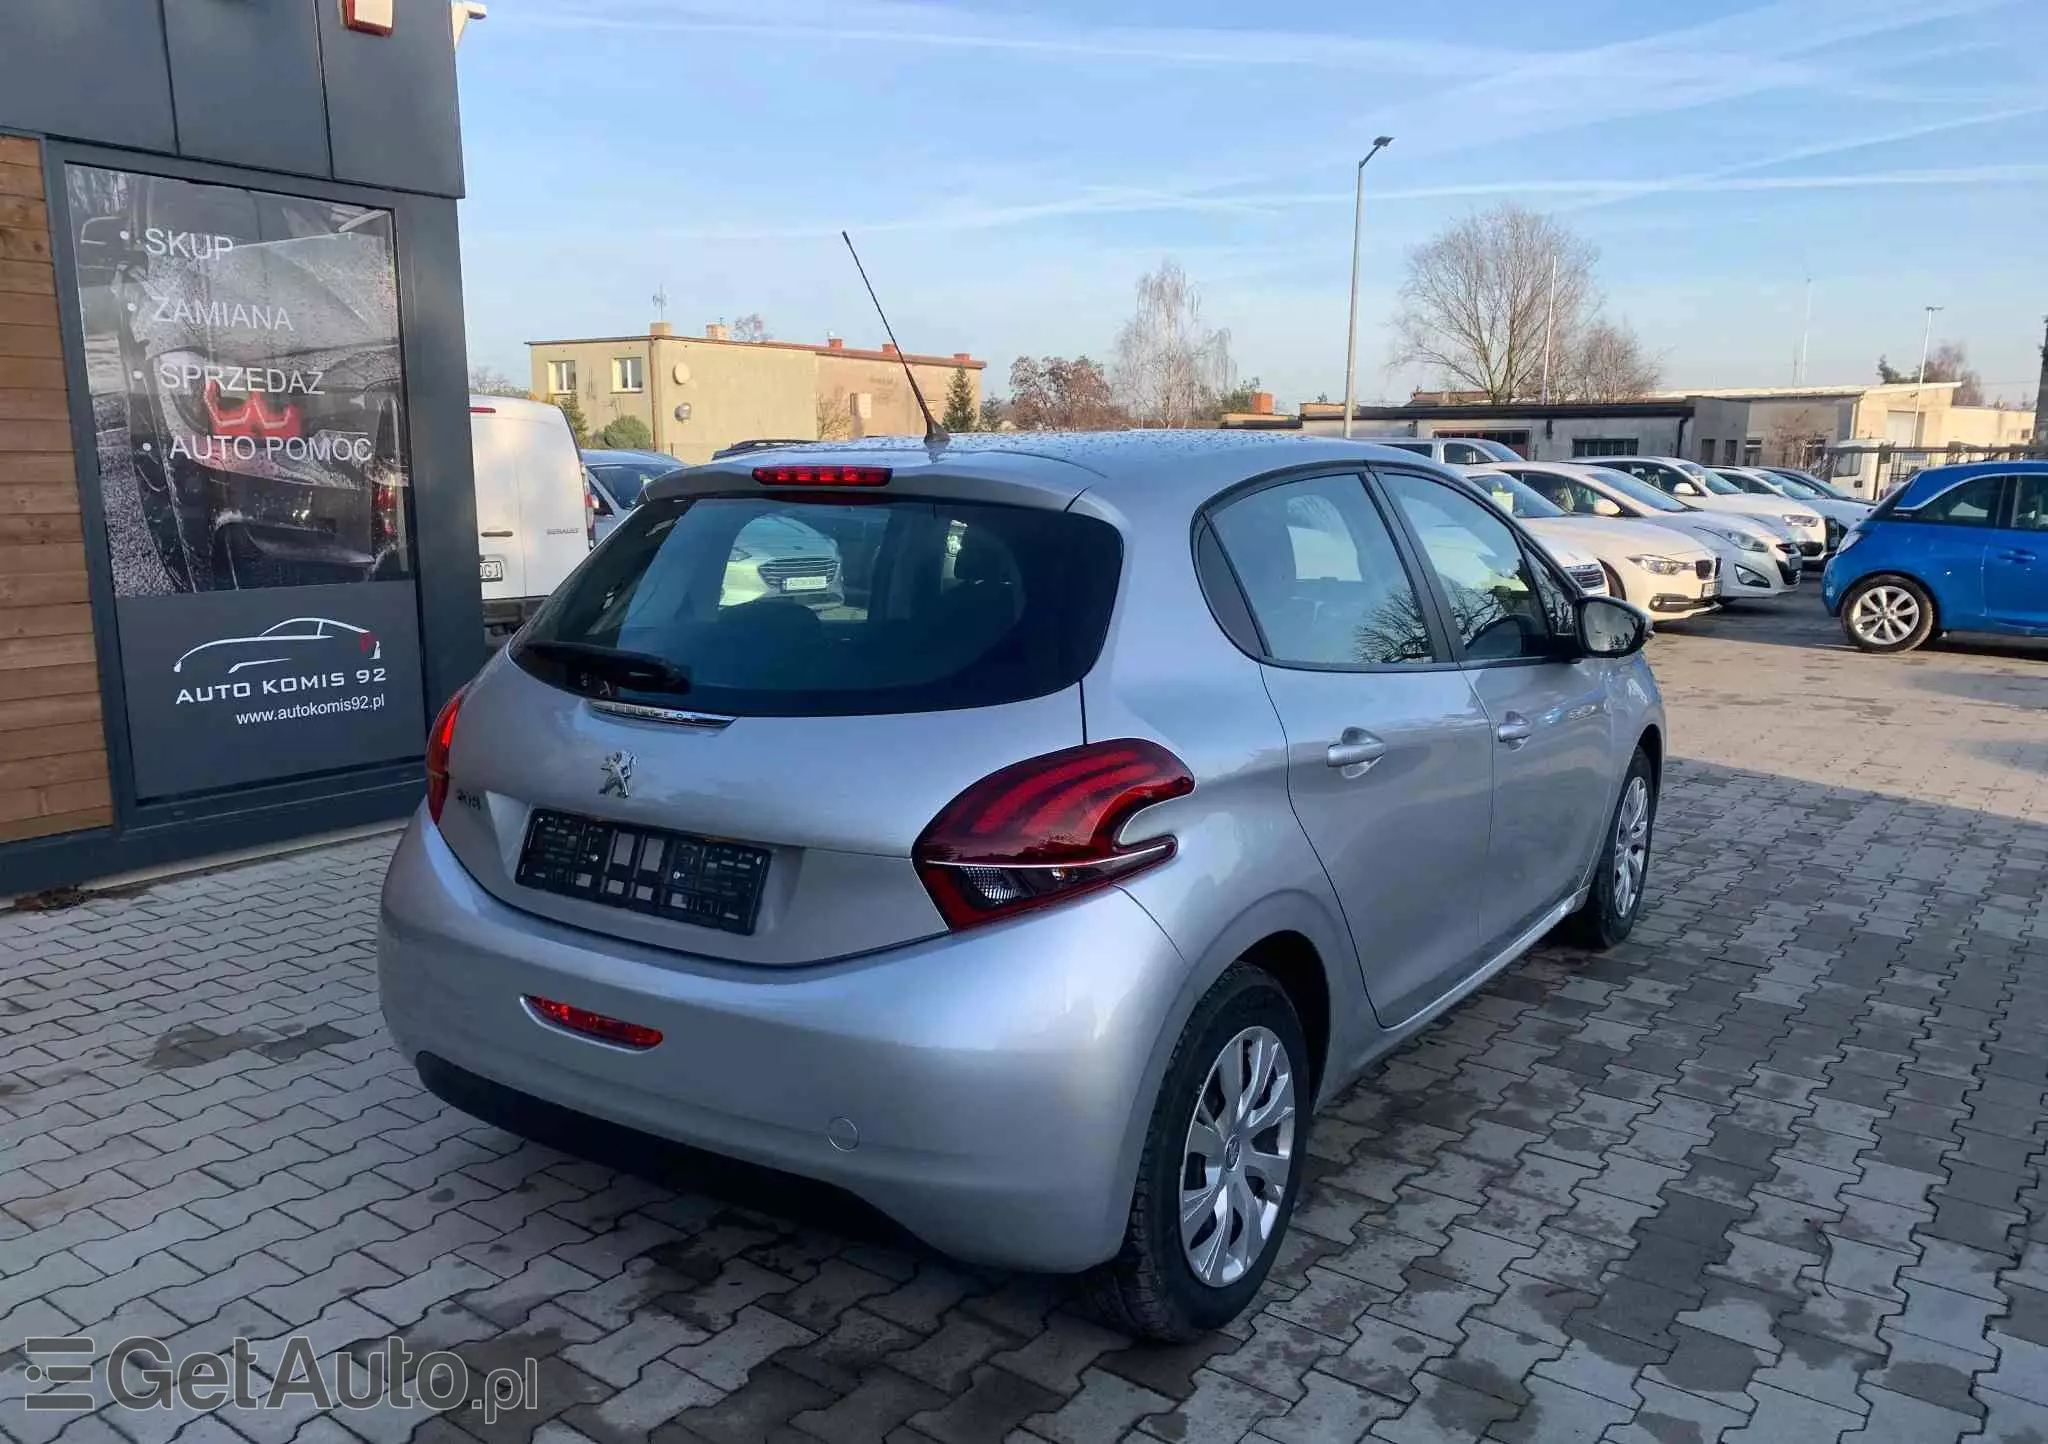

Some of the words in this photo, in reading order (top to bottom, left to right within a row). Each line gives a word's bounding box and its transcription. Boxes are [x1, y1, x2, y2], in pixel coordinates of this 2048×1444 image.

[145, 228, 233, 261] SKUP
[152, 297, 293, 331] ZAMIANA
[169, 435, 257, 461] AUTO
[266, 436, 373, 463] POMOC
[175, 682, 251, 705] AUTO
[263, 672, 345, 695] KOMIS
[356, 667, 387, 682] 92
[236, 693, 385, 725] www.autokomis92.pl
